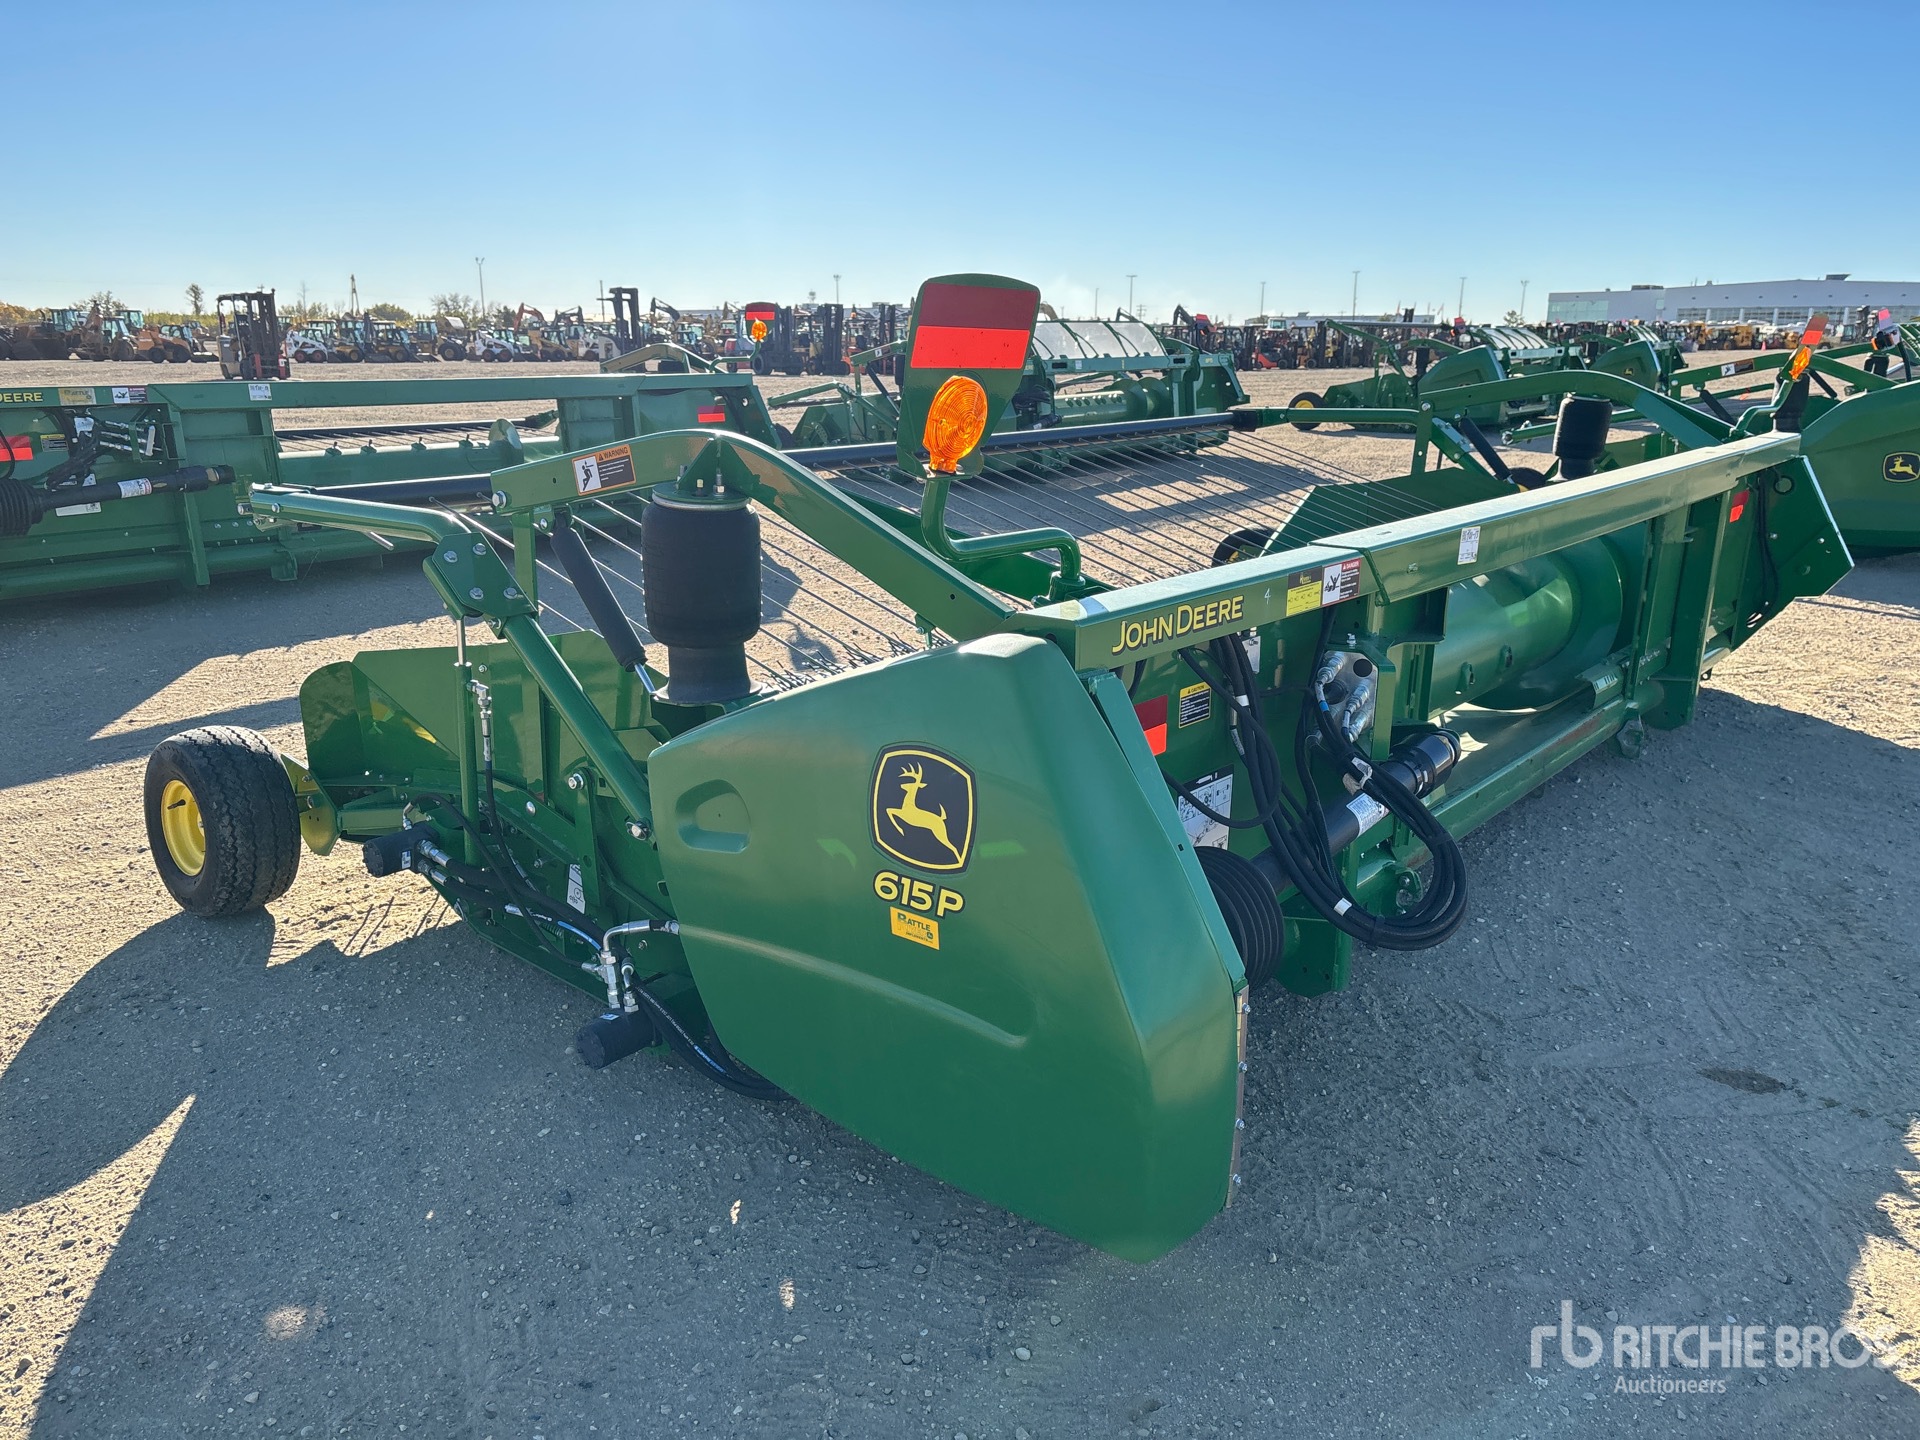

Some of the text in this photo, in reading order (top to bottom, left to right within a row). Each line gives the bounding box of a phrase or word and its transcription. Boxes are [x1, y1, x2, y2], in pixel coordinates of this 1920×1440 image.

[603, 447, 628, 458] WARNING
[1111, 595, 1244, 656] JOHN DEERE
[874, 871, 965, 918] 615P
